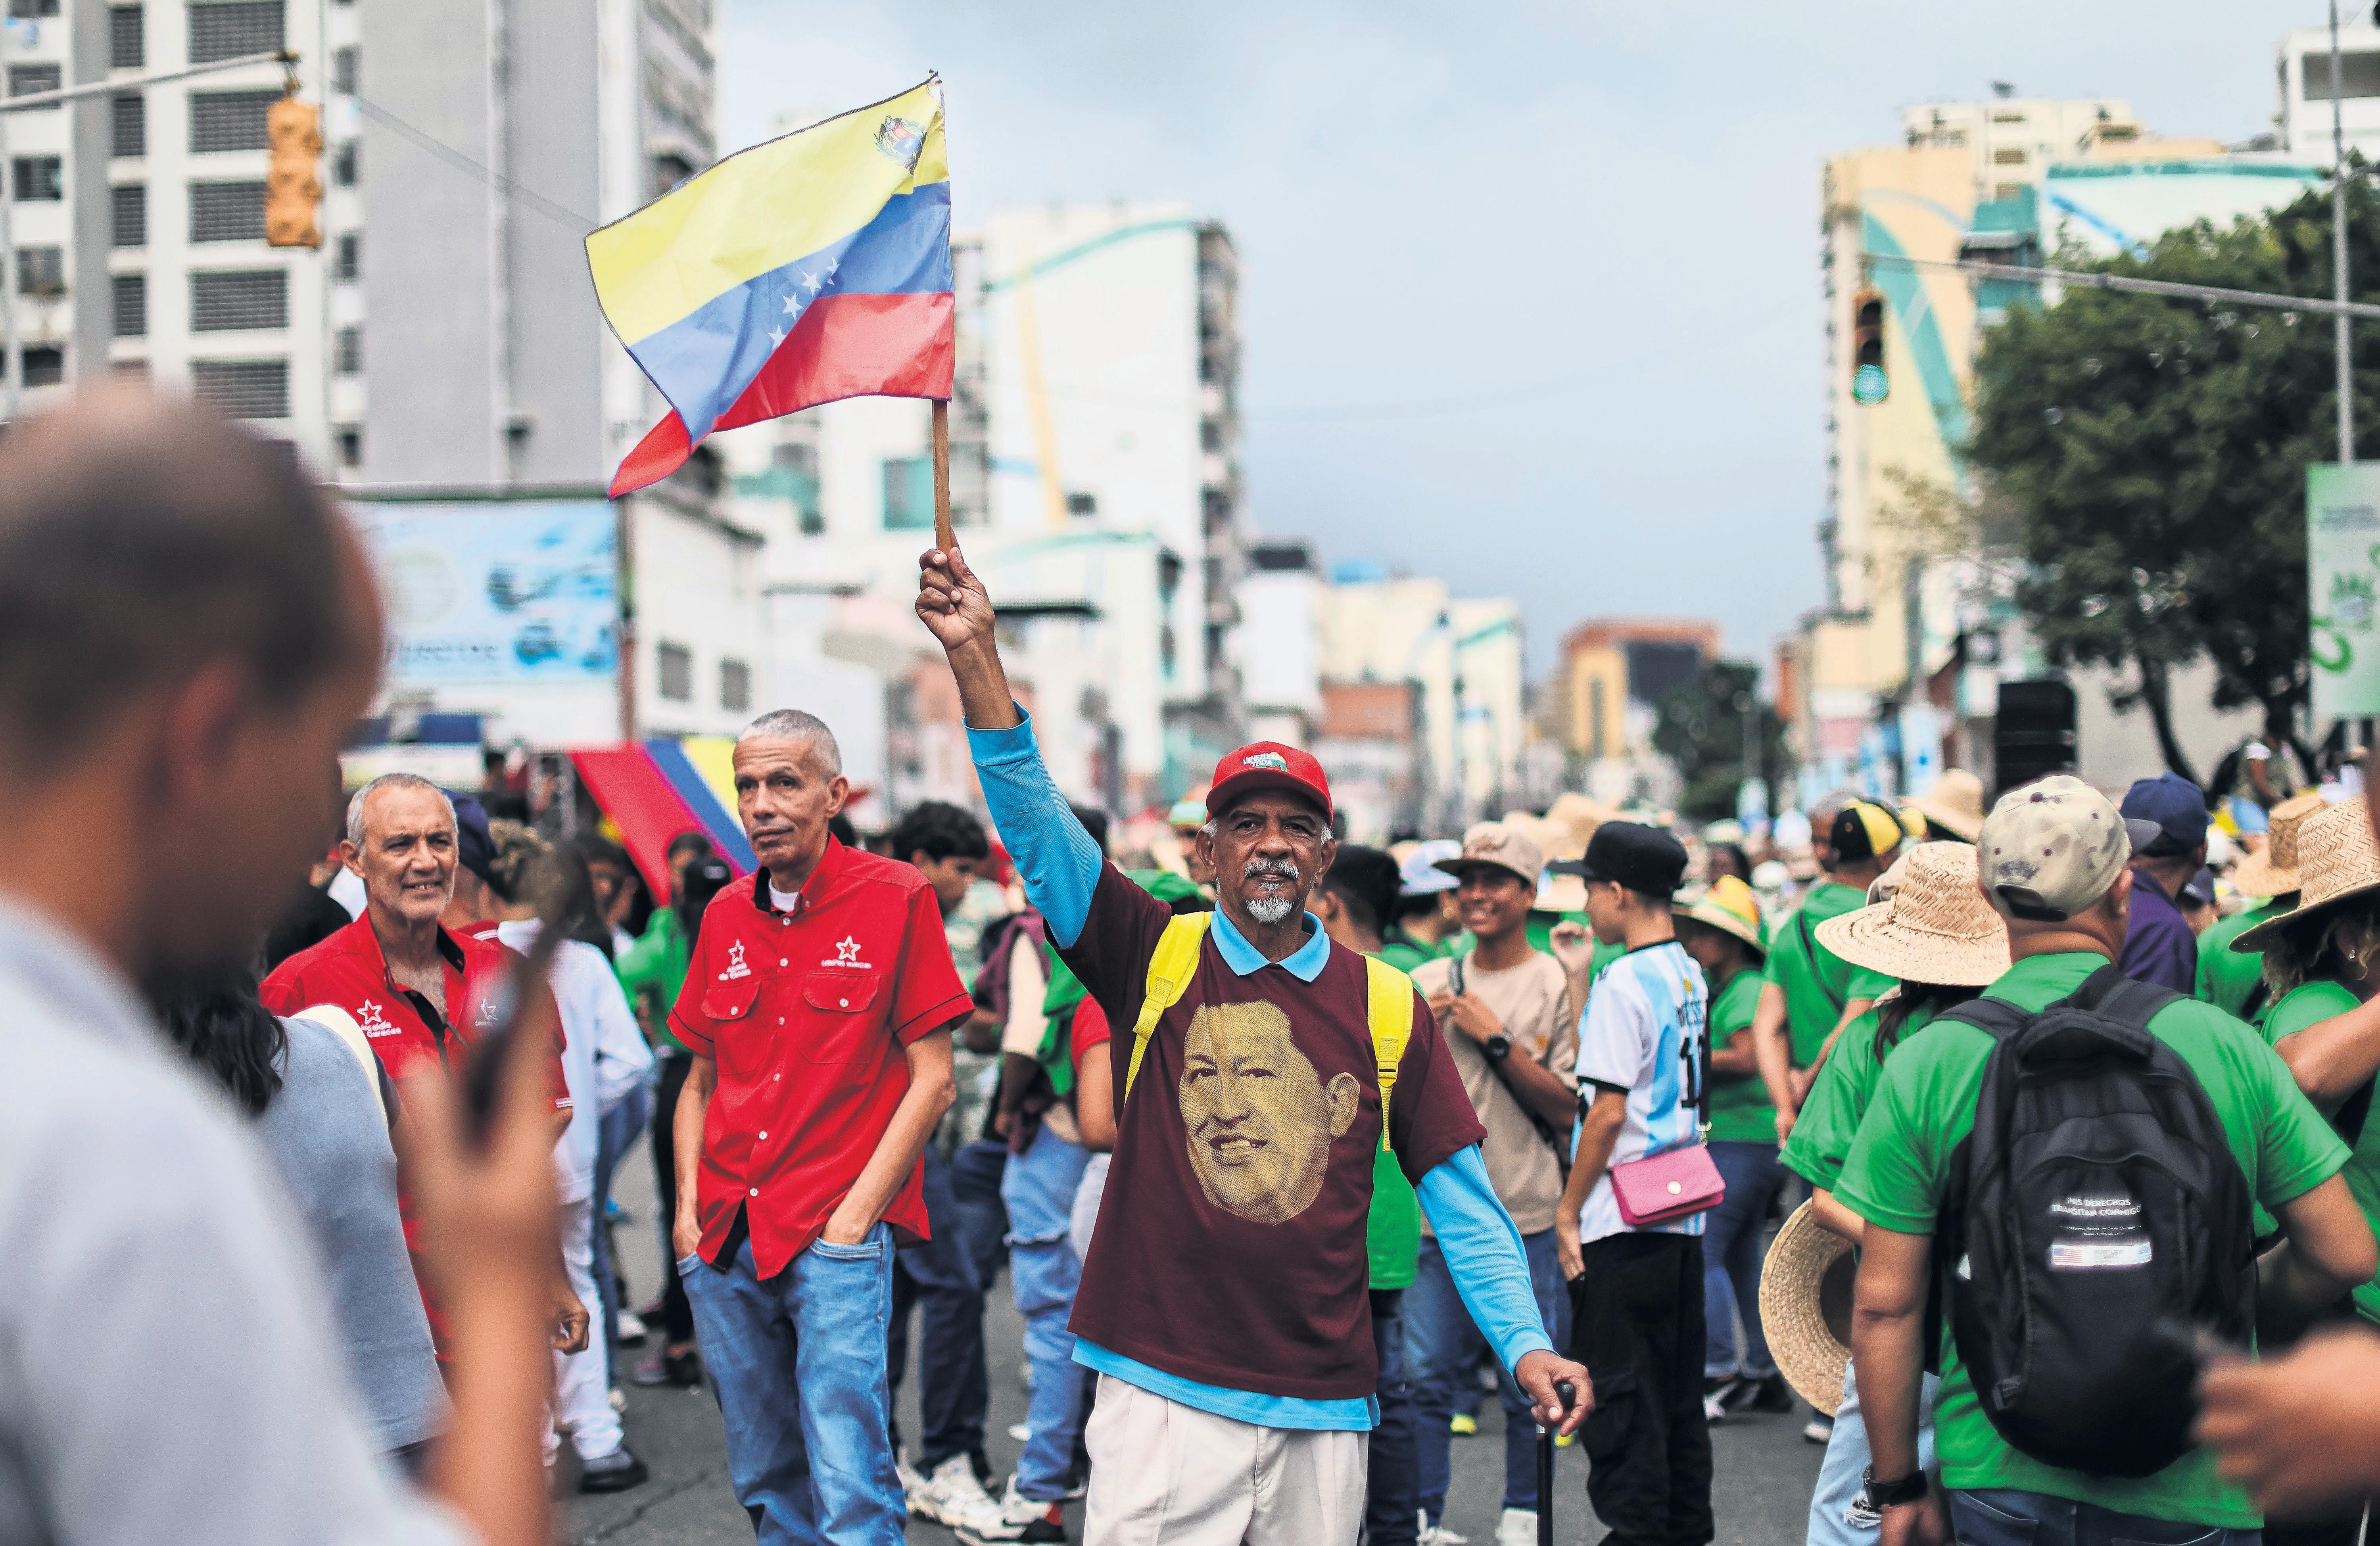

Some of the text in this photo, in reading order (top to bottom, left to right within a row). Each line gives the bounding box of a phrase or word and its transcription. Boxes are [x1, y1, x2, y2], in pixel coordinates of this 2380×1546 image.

[1243, 753, 1280, 765] VENEZUELA
[1250, 759, 1272, 767] TODA
[2052, 1205, 2097, 1216] TRANSITAN
